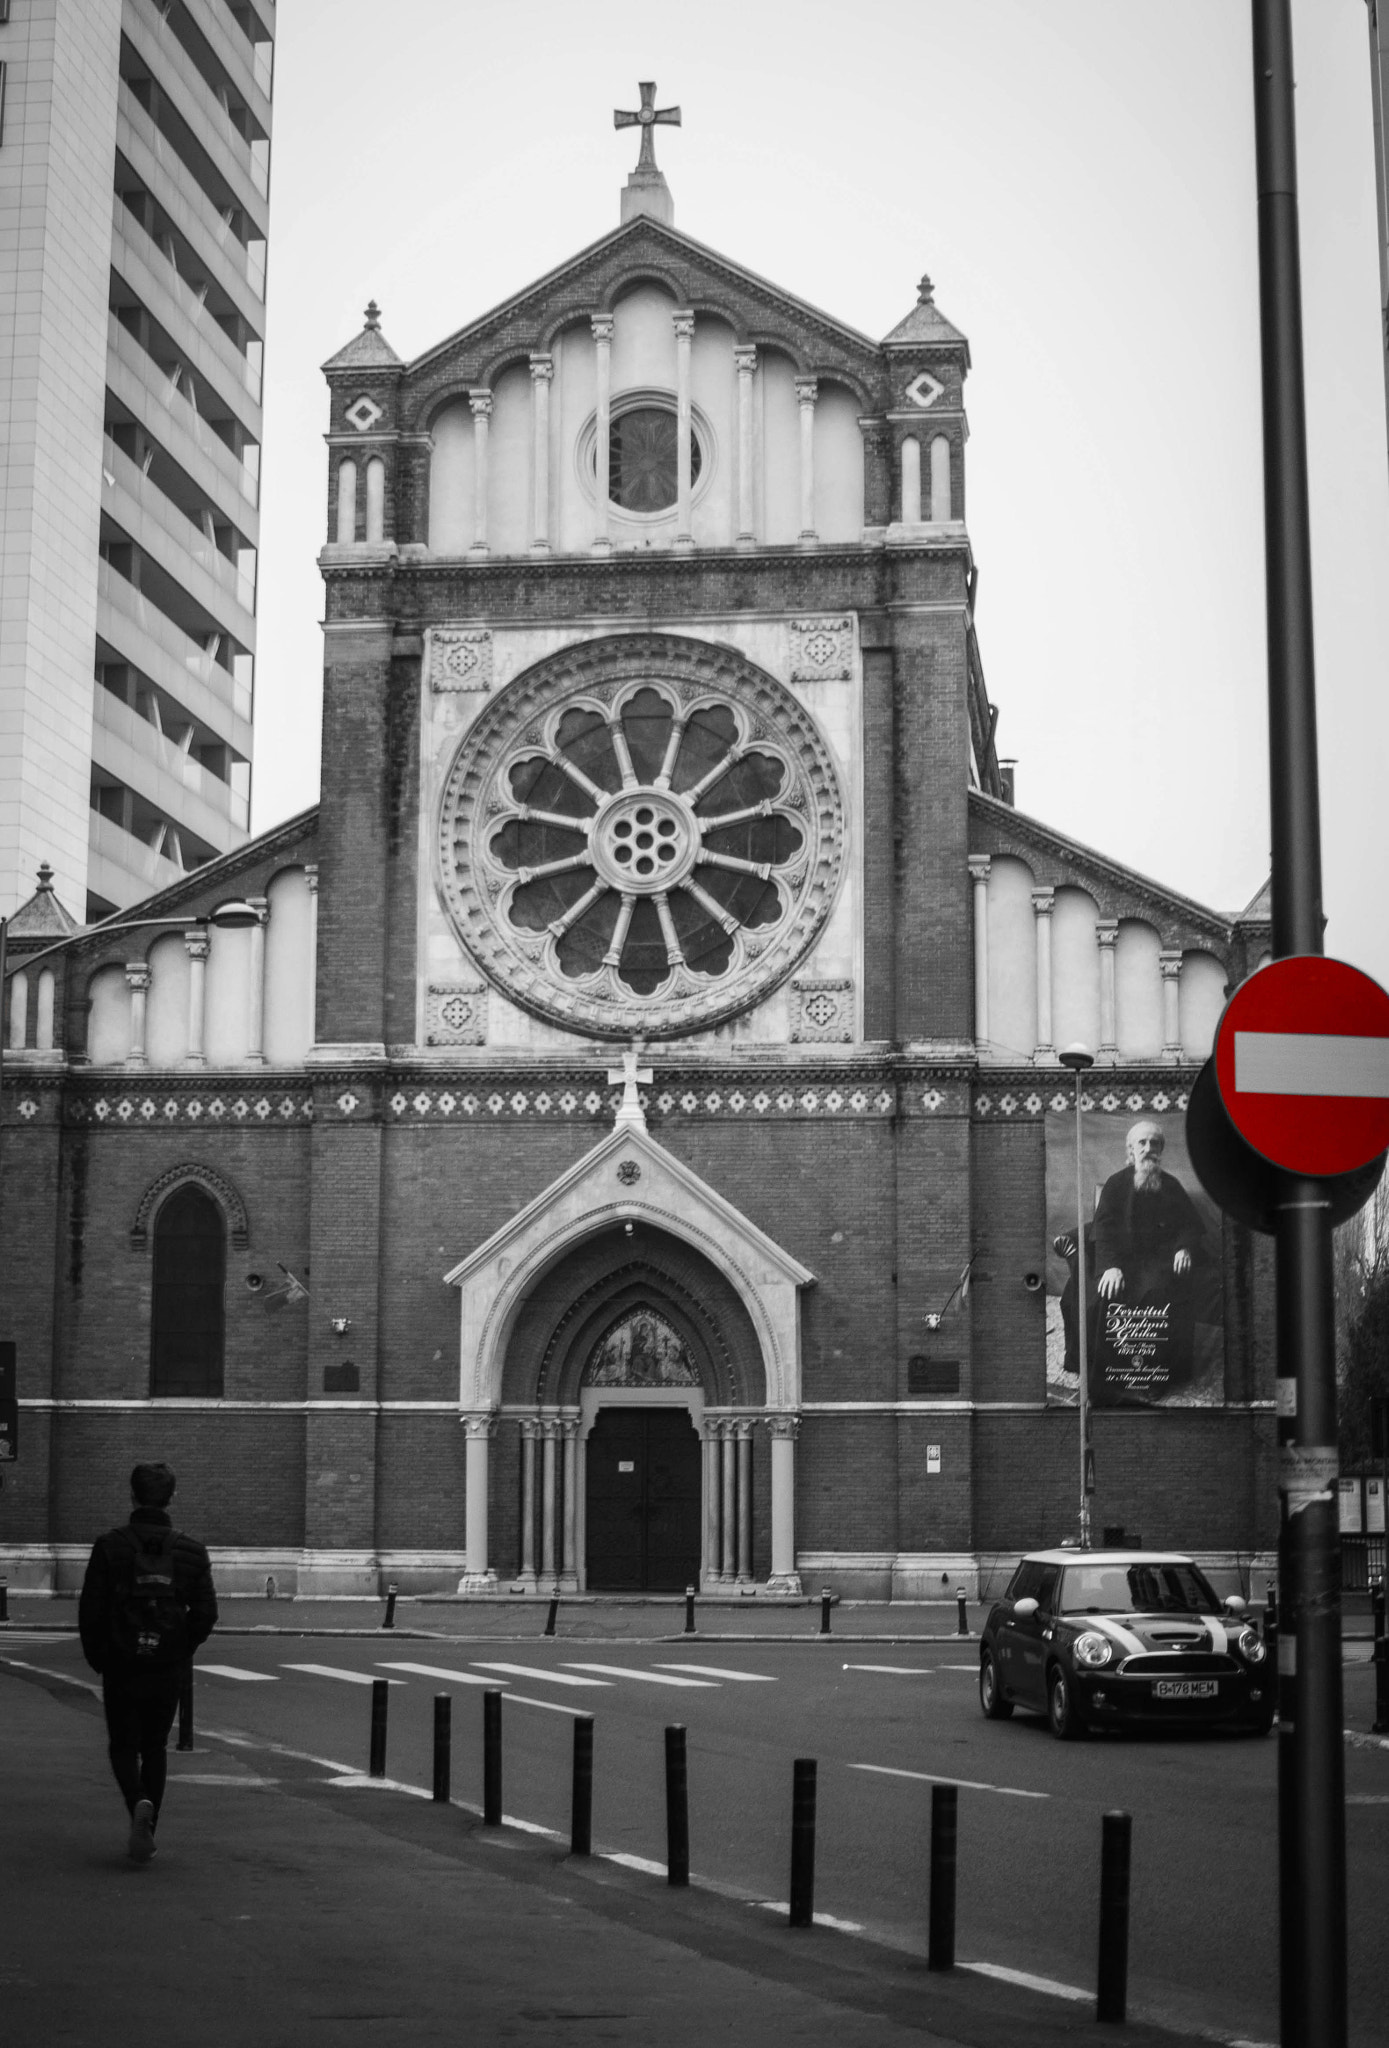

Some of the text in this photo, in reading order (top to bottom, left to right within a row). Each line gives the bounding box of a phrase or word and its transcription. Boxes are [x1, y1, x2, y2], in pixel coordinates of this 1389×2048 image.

[1107, 1303, 1170, 1316] Fericitul
[1106, 1317, 1168, 1333] Vladimir
[1113, 1328, 1157, 1347] Ghika
[1116, 1373, 1151, 1387] August
[1191, 1682, 1214, 1693] MEM
